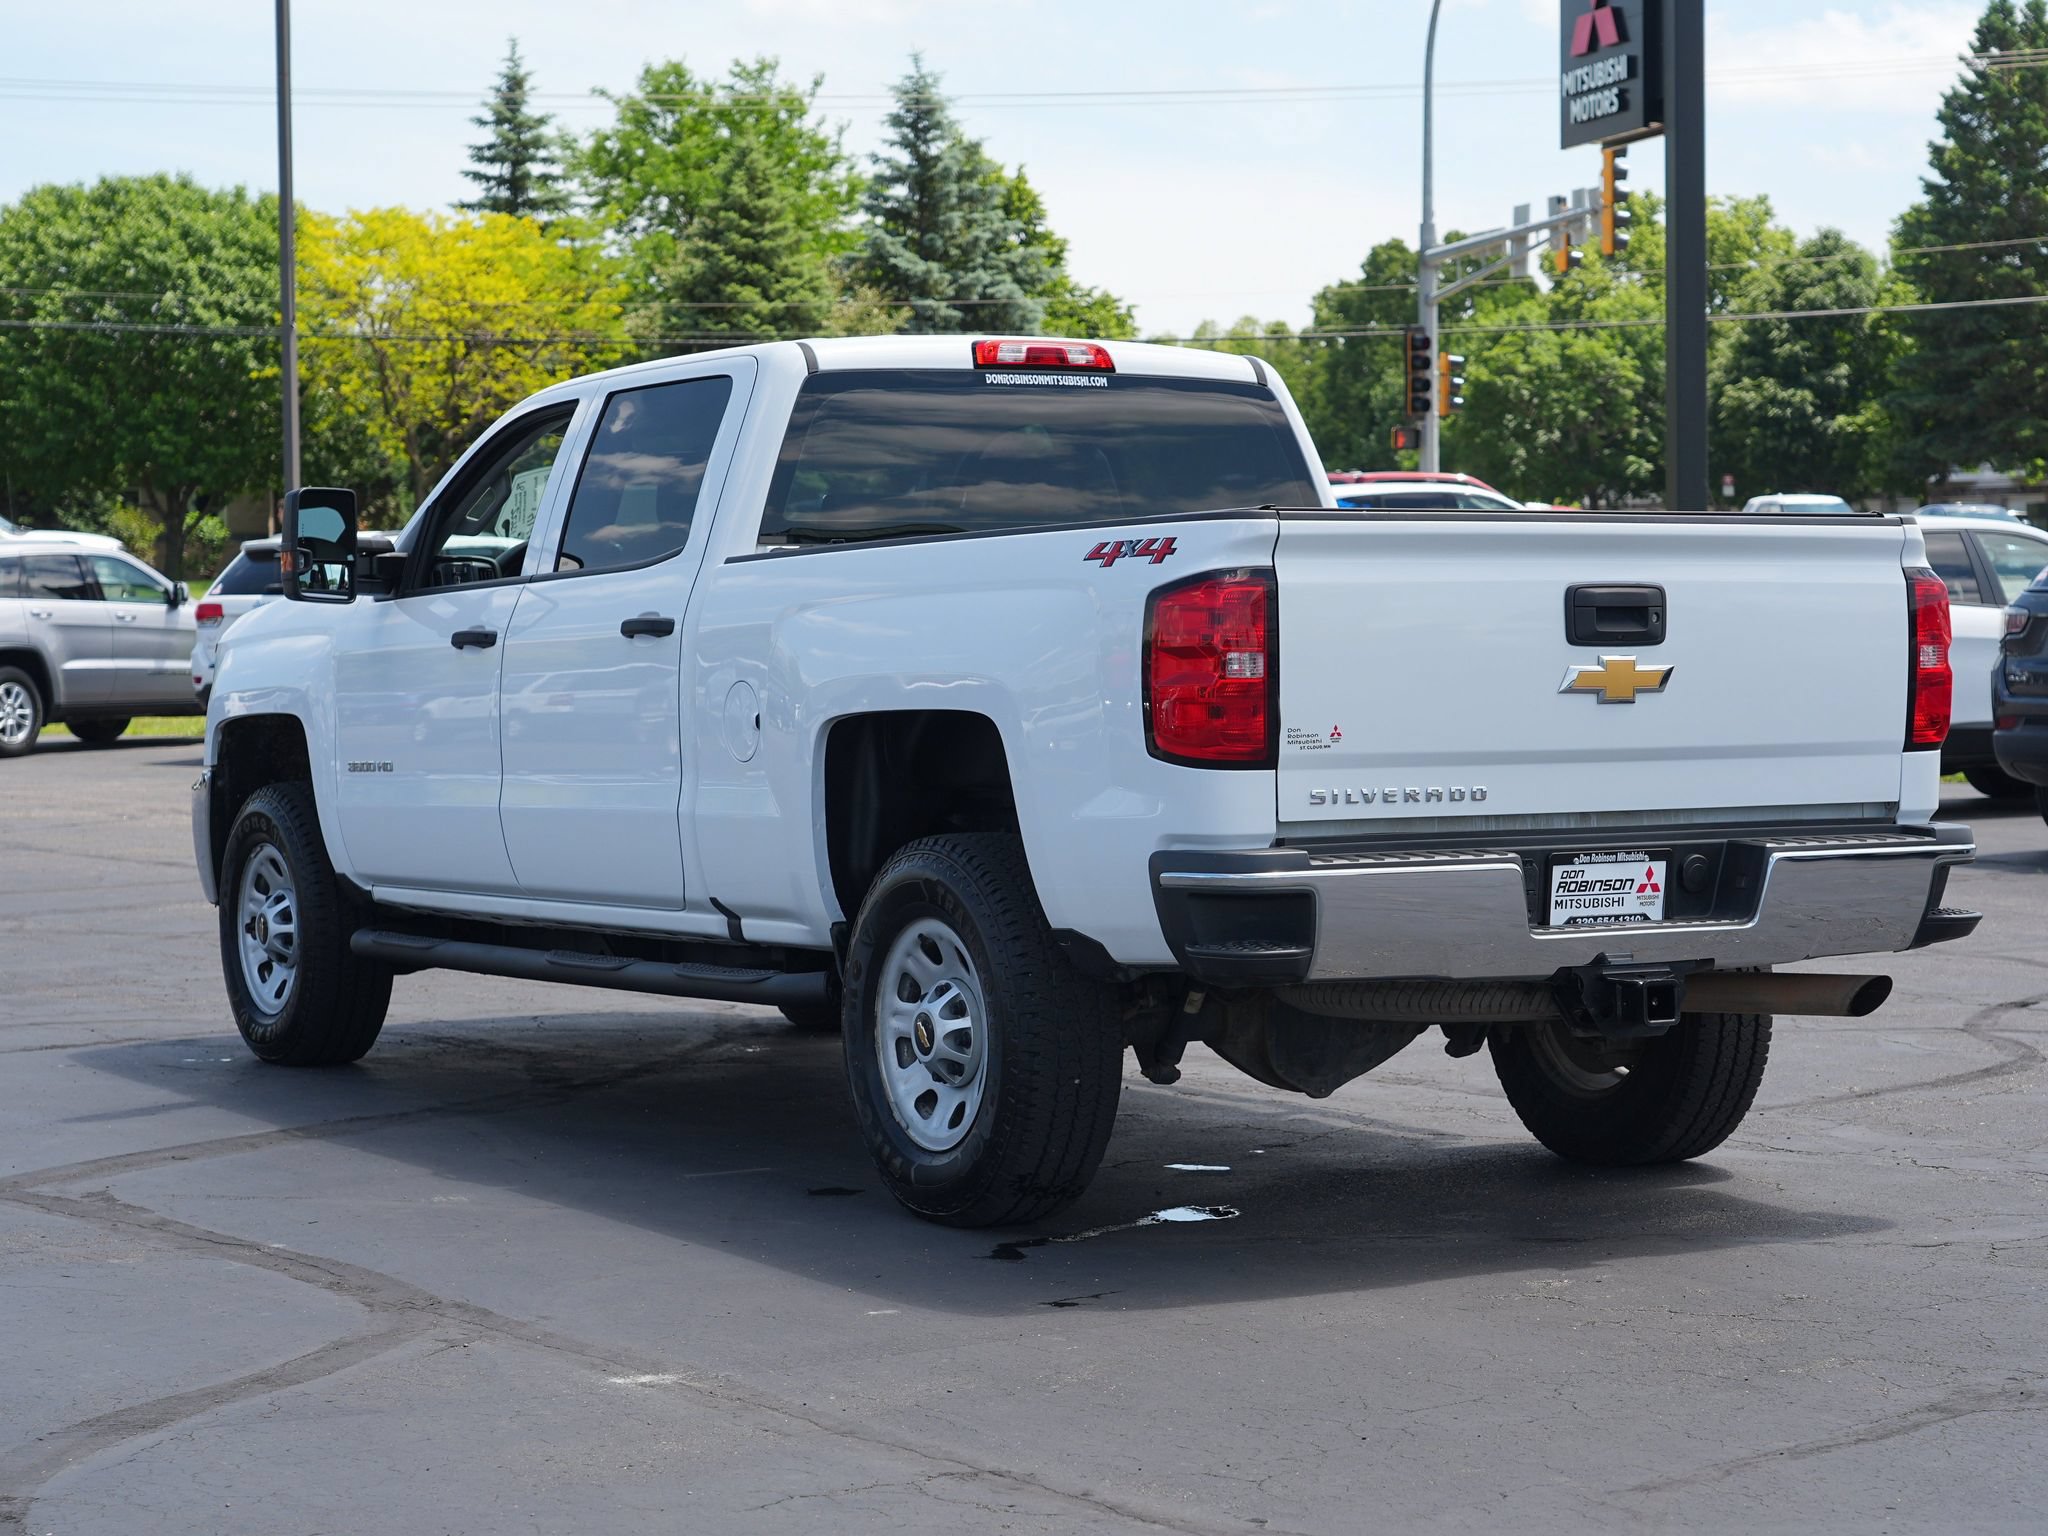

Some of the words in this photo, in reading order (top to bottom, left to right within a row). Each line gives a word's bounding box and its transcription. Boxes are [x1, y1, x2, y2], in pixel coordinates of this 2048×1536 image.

[1562, 54, 1628, 97] MITSUBISHI
[1570, 87, 1620, 124] MOTORS
[985, 374, 1108, 386] DONROBINSONMITSUBISHI.COM
[1310, 786, 1488, 805] SILVERADO
[1580, 854, 1590, 863] Don
[1591, 852, 1616, 862] Robinson
[1617, 851, 1645, 862] Mitsubishi
[1556, 878, 1634, 893] ROBINSON
[1554, 896, 1625, 910] MITSUBISHI
